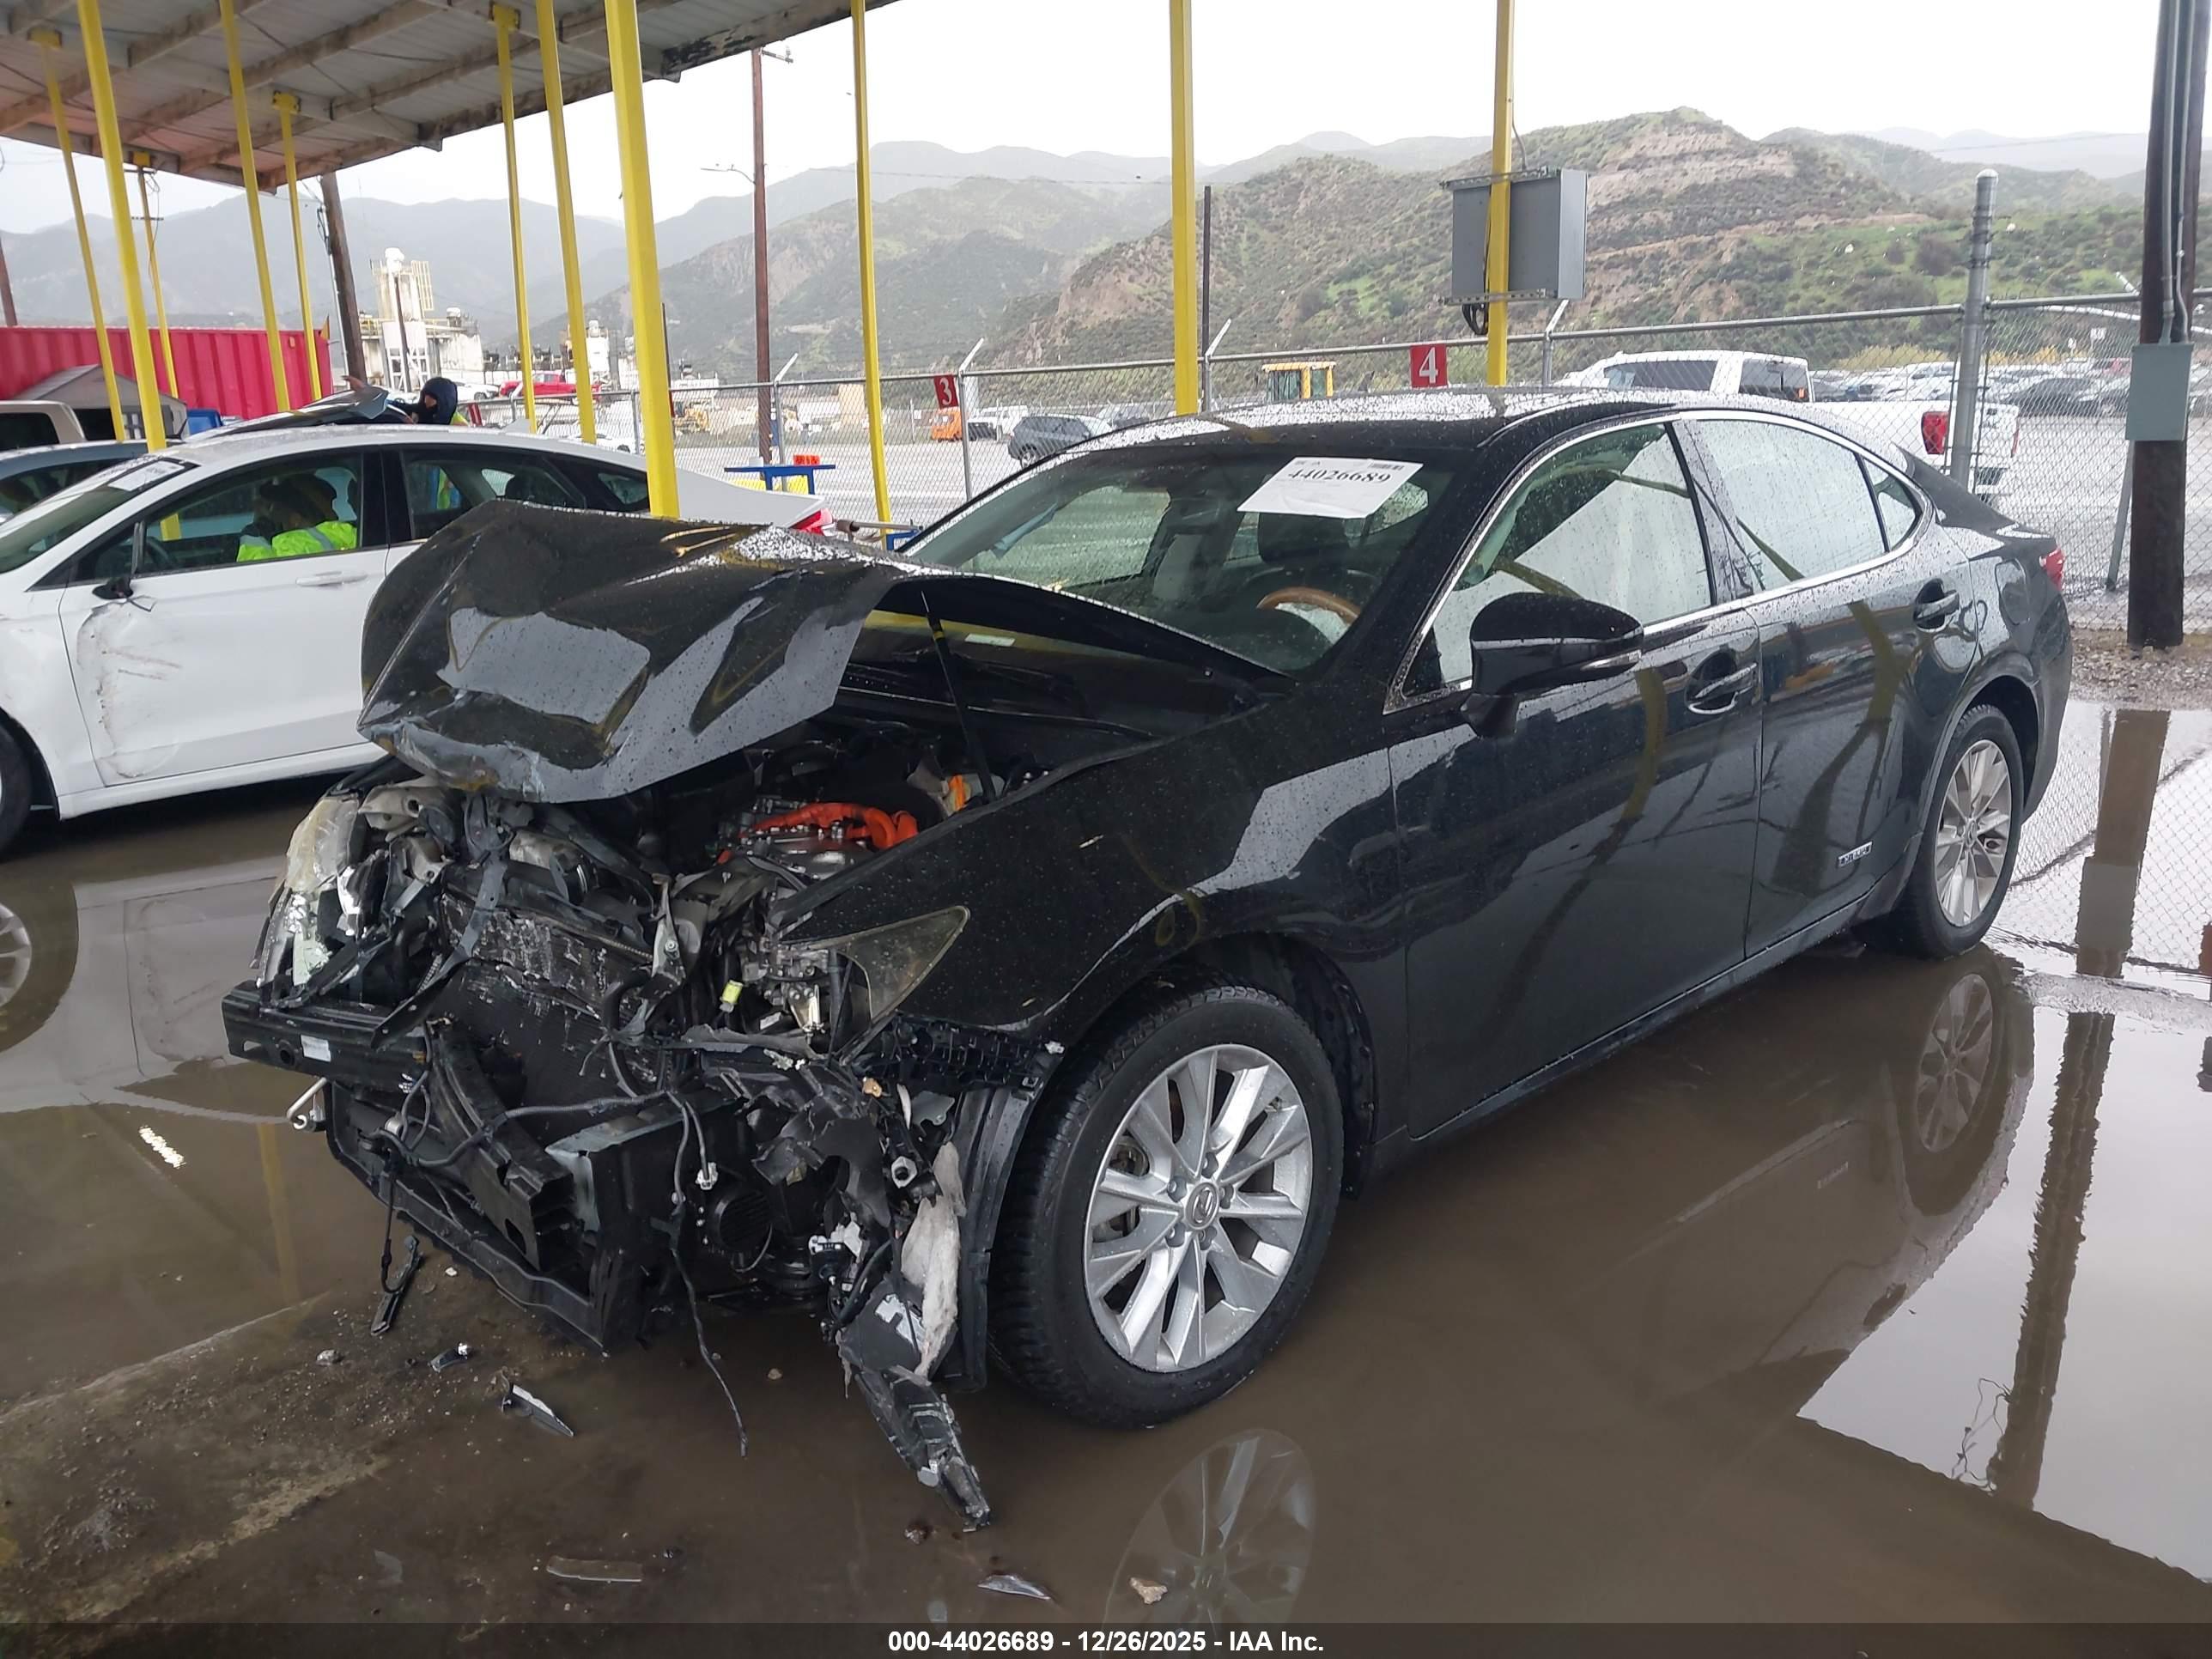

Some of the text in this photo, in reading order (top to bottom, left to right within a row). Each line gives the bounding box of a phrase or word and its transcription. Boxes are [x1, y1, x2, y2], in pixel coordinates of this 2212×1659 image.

[1419, 346, 1439, 385] 4
[939, 377, 953, 405] 3
[1288, 468, 1392, 483] 44026689
